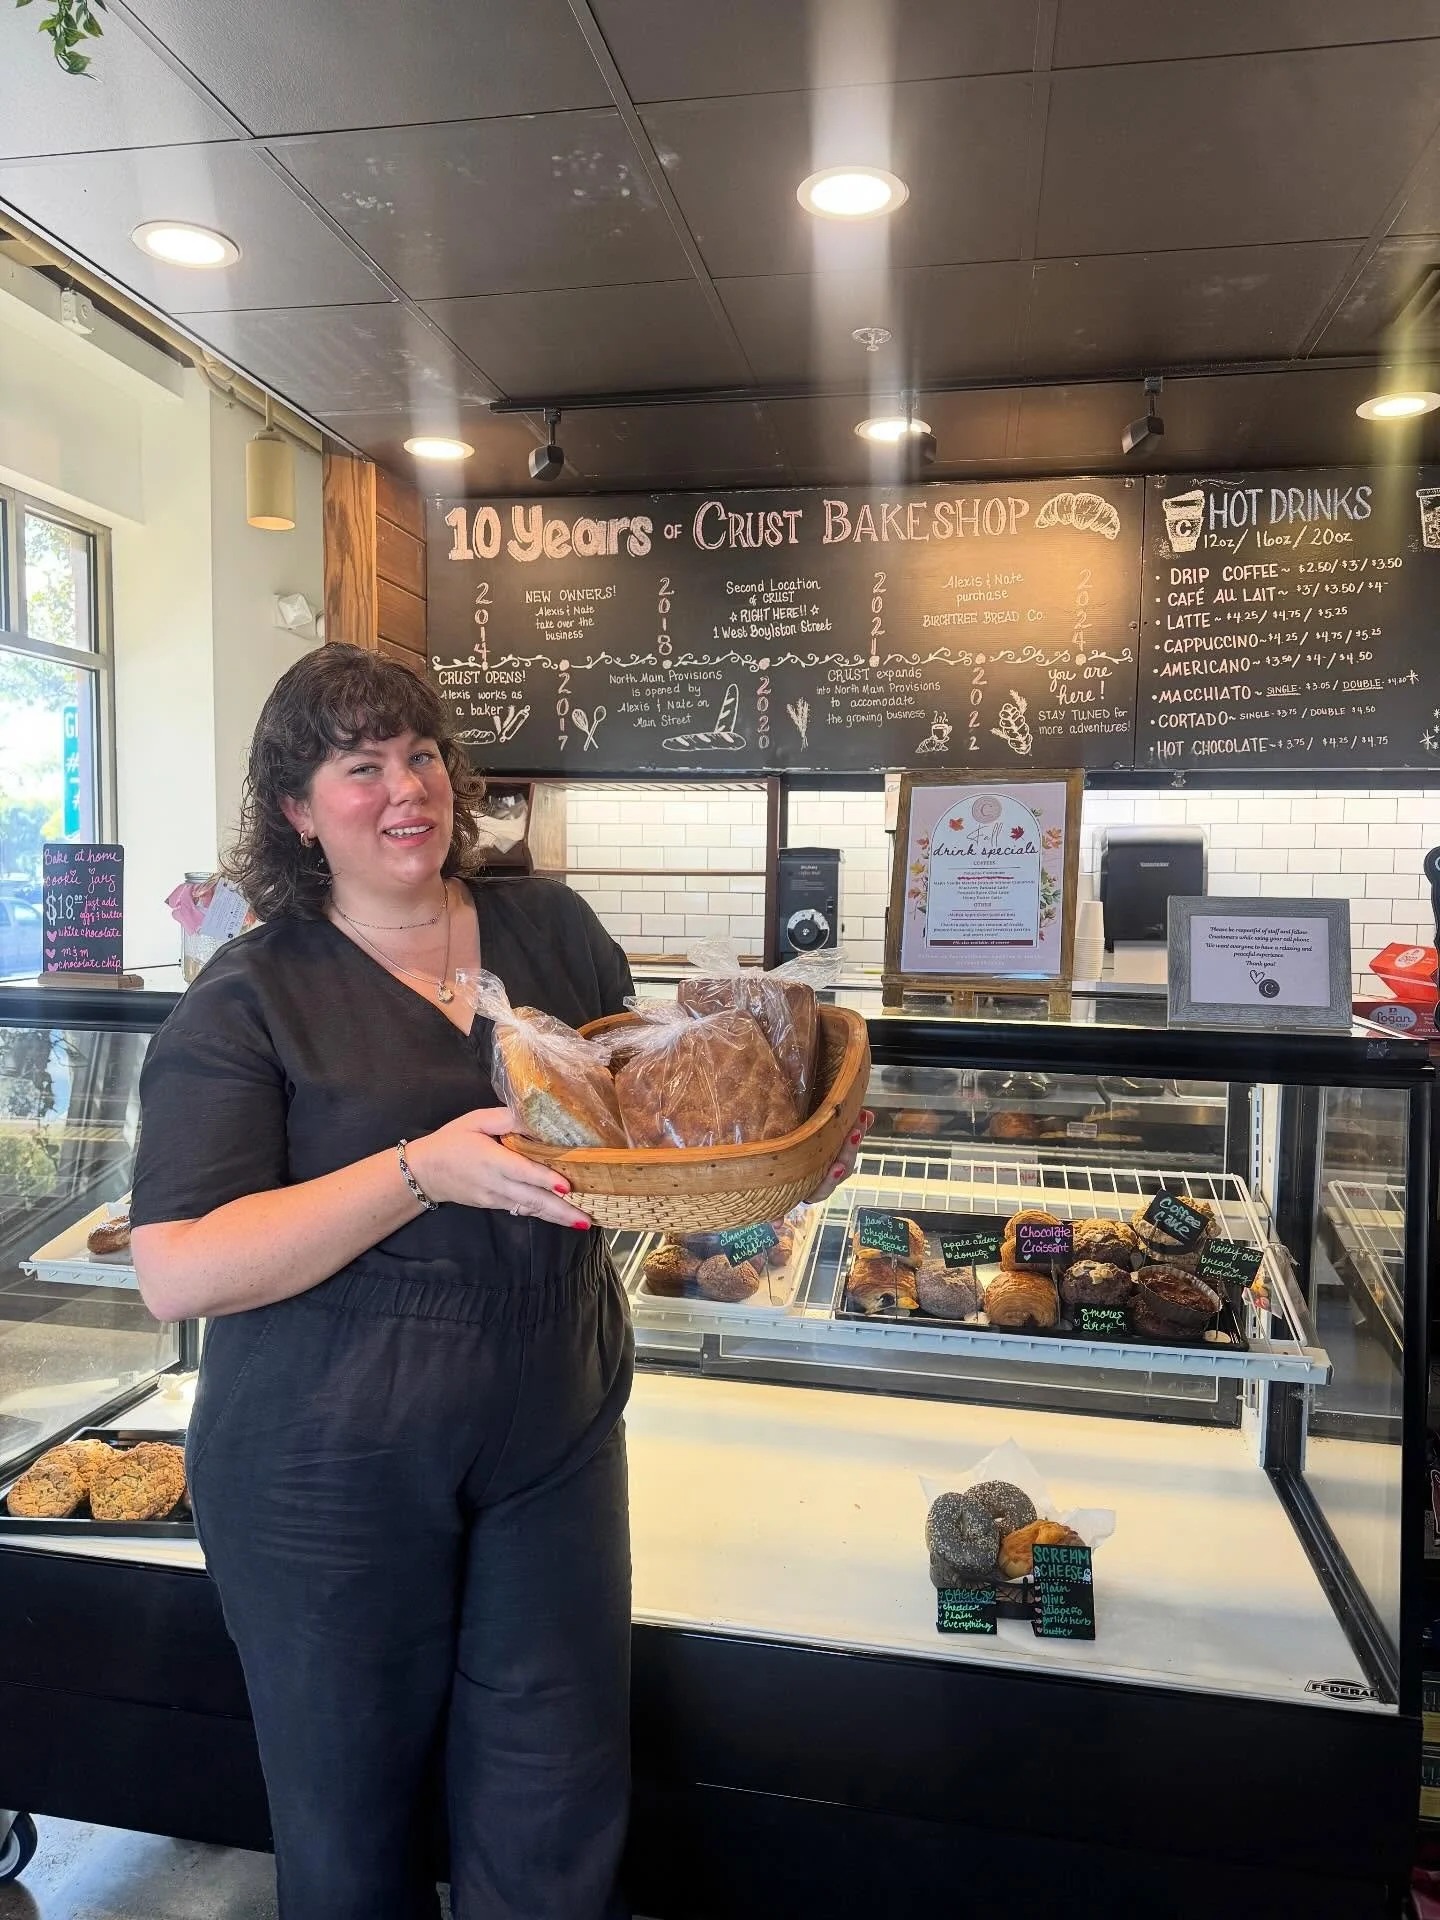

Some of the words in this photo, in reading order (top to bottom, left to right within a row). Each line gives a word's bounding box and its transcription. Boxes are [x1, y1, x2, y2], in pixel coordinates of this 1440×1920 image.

[1209, 488, 1263, 531] HOT
[1269, 485, 1373, 525] DRINKS
[445, 507, 501, 560] 10
[507, 505, 653, 562] Years
[1310, 527, 1353, 546] 20oz
[1170, 567, 1210, 585] DRIP
[1372, 557, 1403, 570] $3.50
[726, 579, 764, 595] Second
[771, 578, 821, 592] Location
[942, 576, 982, 589] Alexis
[995, 572, 1024, 585] Nate
[525, 590, 551, 603] NEW
[559, 585, 617, 602] OWNERS!
[749, 594, 757, 606] of
[763, 591, 794, 604] CRUST
[956, 589, 1009, 607] purchase
[1167, 587, 1205, 607] CAFÉ
[1213, 588, 1238, 603] AU
[536, 606, 564, 616] Alexis
[573, 605, 595, 615] Nate
[740, 607, 771, 623] RIGHT
[1167, 612, 1211, 630] LATTE
[1318, 606, 1348, 619] $5.25
[536, 619, 555, 630] take
[557, 619, 574, 629] over
[579, 617, 595, 627] the
[922, 611, 977, 628] BIRCHTREE
[983, 610, 1019, 624] BREAD
[545, 629, 584, 641] business
[713, 626, 720, 639] 1
[721, 626, 748, 639] West
[750, 623, 797, 640] Boylston
[800, 618, 832, 632] Street
[1355, 627, 1382, 641] $5.25
[438, 670, 480, 685] CRUST
[485, 671, 526, 684] OPENS!
[609, 673, 638, 684] North
[639, 671, 665, 683] Main
[668, 670, 722, 682] Provisions
[827, 668, 870, 683] CRUST
[876, 667, 922, 681] expands
[1048, 668, 1076, 693] you
[1084, 666, 1112, 680] are
[440, 690, 470, 700] Alexis
[478, 689, 507, 700] works
[511, 692, 523, 700] as
[632, 689, 640, 697] is
[645, 685, 680, 698] opened
[688, 684, 701, 697] by
[816, 686, 831, 695] into
[834, 684, 859, 694] North
[862, 685, 884, 694] Main
[889, 681, 941, 693] Provisions
[1158, 685, 1251, 704] MACCHIATO
[617, 702, 650, 713] Alexis
[667, 701, 694, 710] Nate
[697, 700, 710, 708] on
[831, 697, 840, 707] to
[850, 696, 915, 707] accomodate
[456, 707, 464, 716] a
[470, 703, 504, 717] baker
[1038, 710, 1065, 721] STAY
[1071, 709, 1110, 719] TUNED
[1114, 707, 1128, 718] for
[633, 719, 656, 728] Main
[661, 715, 692, 727] Street
[826, 714, 842, 725] the
[846, 713, 882, 727] growing
[886, 710, 925, 720] business
[1039, 725, 1063, 735] more
[1069, 721, 1131, 734] adventures!
[1157, 740, 1184, 758] HOT
[966, 822, 1003, 847] Fall
[44, 848, 69, 865] Bake
[75, 850, 85, 862] at
[87, 849, 122, 864] home
[933, 842, 977, 857] drink
[980, 841, 1038, 858] specials
[45, 871, 81, 887] cookie
[84, 895, 101, 911] just
[102, 897, 118, 907] add
[81, 927, 121, 938] chocolate
[1236, 927, 1260, 935] respectful
[58, 958, 100, 970] chocolate
[101, 957, 122, 972] chip
[1159, 1196, 1201, 1229] Coffee
[864, 1216, 885, 1227] ham
[1153, 1211, 1190, 1238] Cake
[864, 1226, 902, 1242] cheddar
[1020, 1226, 1071, 1238] Chocolate
[943, 1240, 972, 1251] apple
[973, 1235, 998, 1245] cider
[1022, 1239, 1069, 1253] Croissant
[954, 1249, 989, 1260] donuts
[1209, 1242, 1242, 1260] honey
[1241, 1252, 1262, 1263] oat
[1201, 1254, 1232, 1270] bread
[1203, 1266, 1250, 1284] pudding
[1033, 1545, 1089, 1565] SCREAM
[1040, 1564, 1083, 1580] CHEESE
[1311, 1683, 1380, 1698] FEDERAL
